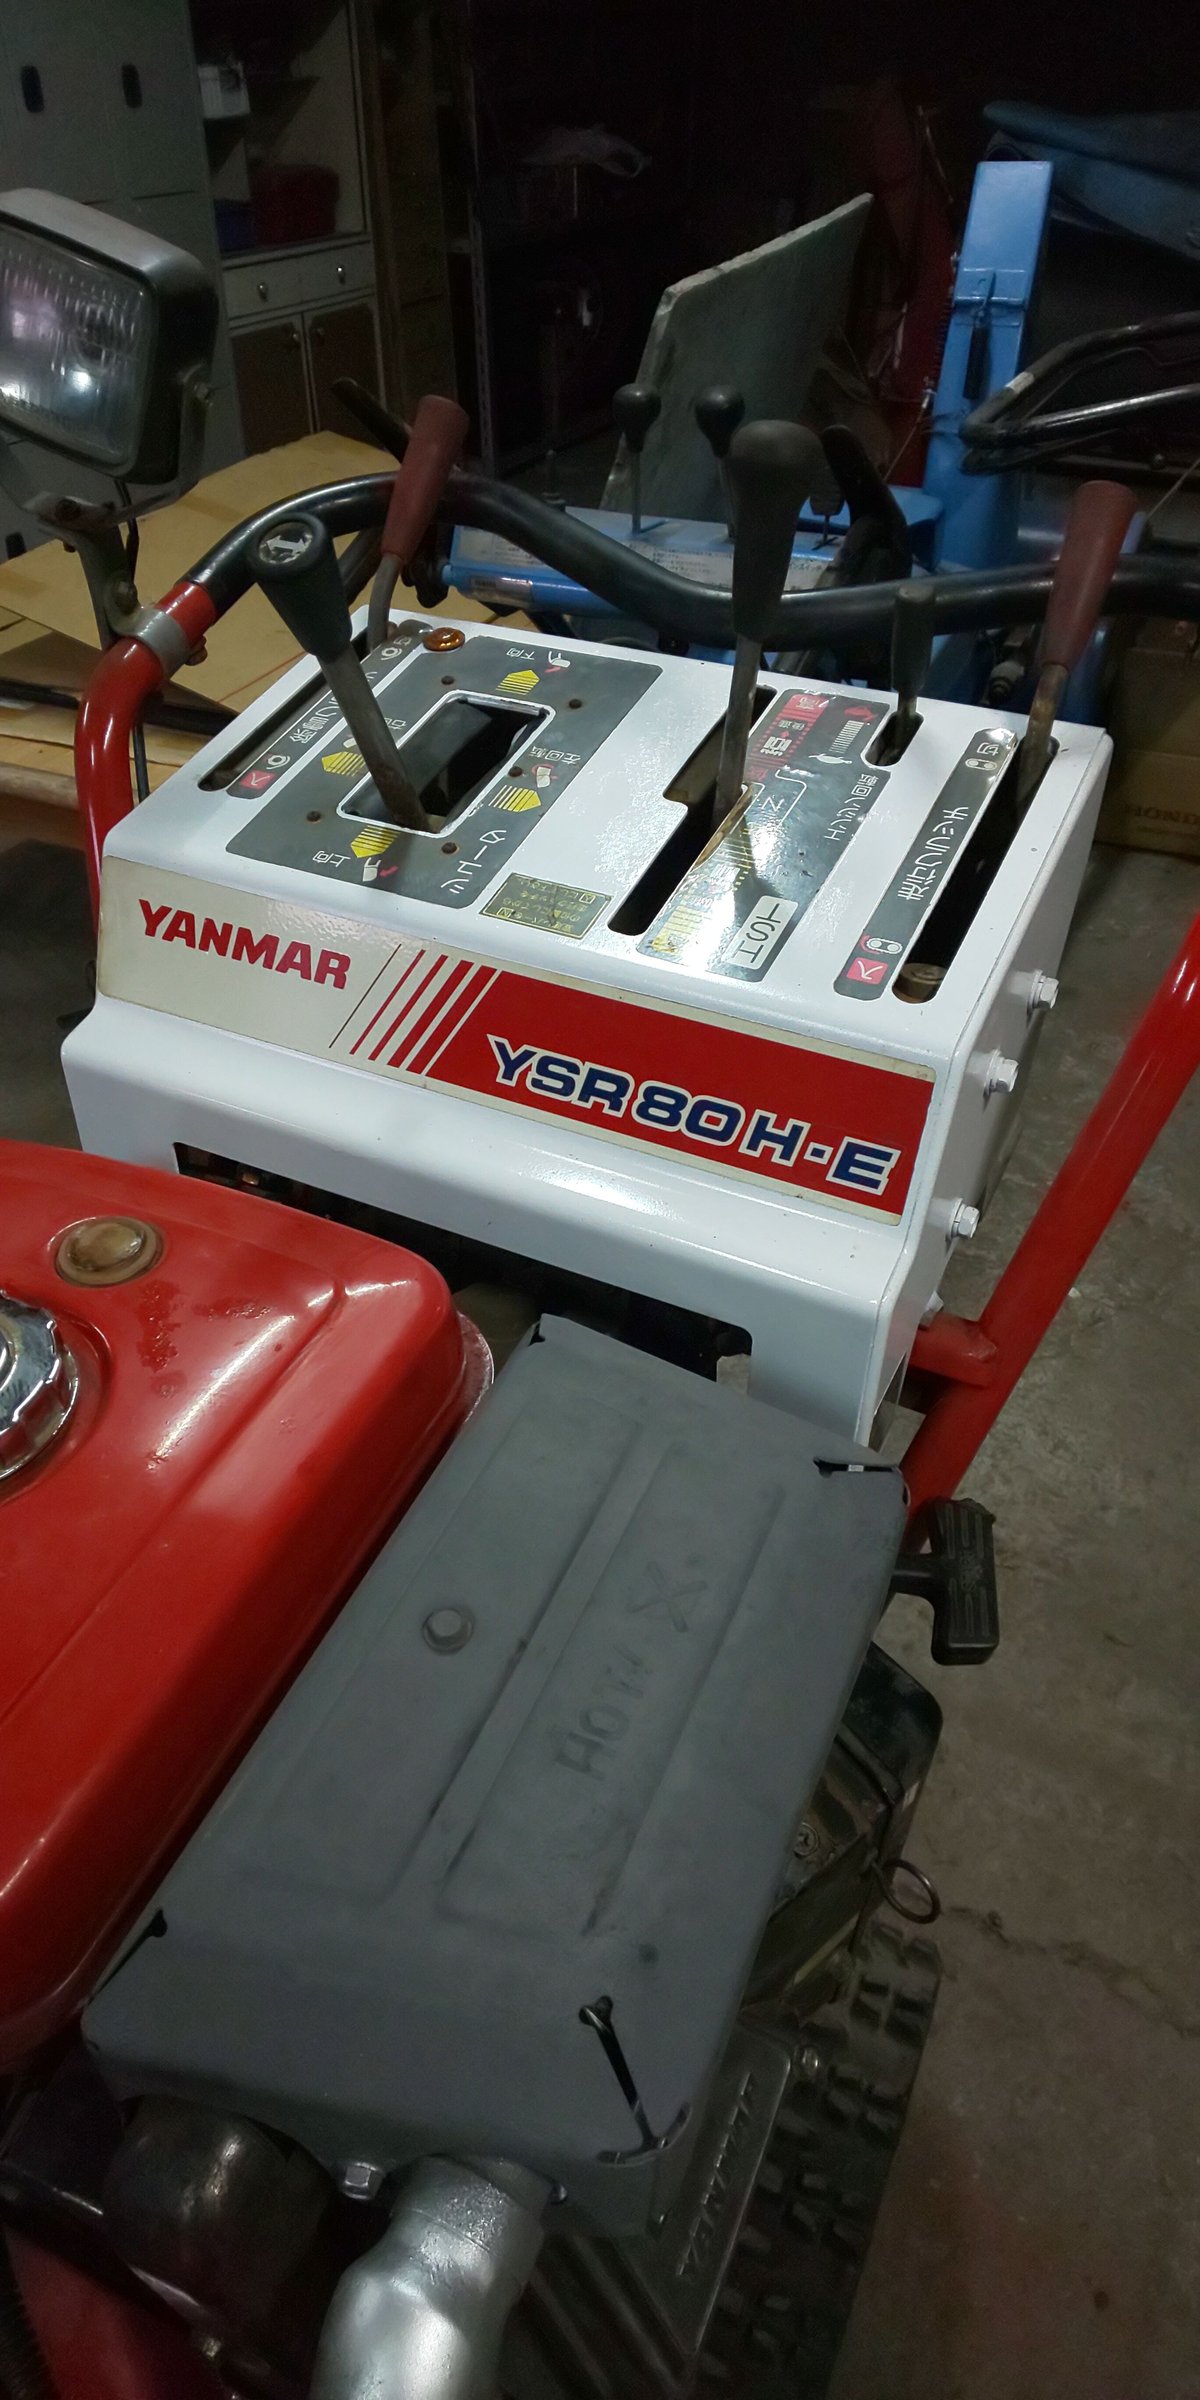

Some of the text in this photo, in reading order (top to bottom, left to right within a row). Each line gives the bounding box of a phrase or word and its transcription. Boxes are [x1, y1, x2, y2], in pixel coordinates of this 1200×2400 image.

[528, 745, 581, 766] 左回転
[823, 773, 879, 841] エンジン回転
[312, 850, 351, 868] 上向
[897, 805, 969, 901] 走行クラッチ
[138, 898, 351, 991] YANMAR
[735, 902, 783, 964] HST
